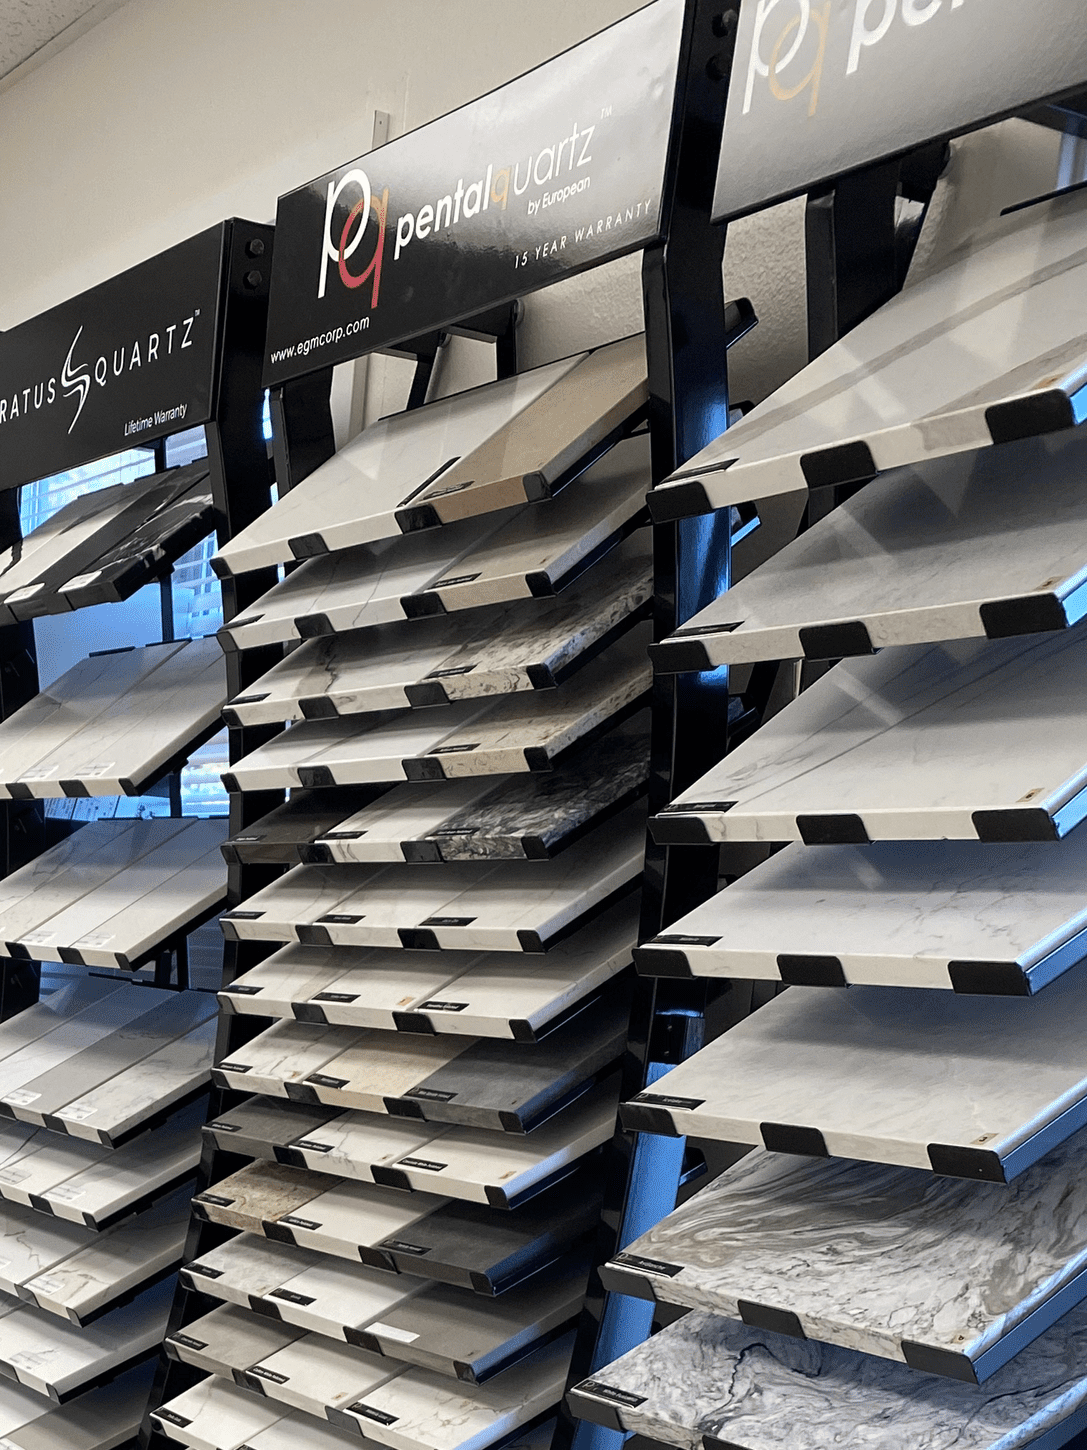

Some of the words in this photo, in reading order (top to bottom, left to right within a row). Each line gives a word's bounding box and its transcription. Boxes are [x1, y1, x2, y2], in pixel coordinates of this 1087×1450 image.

[527, 198, 541, 215] by
[541, 175, 591, 209] European
[514, 254, 529, 269] 15
[535, 234, 568, 261] YEAR
[574, 200, 652, 244] WARRANTY
[94, 317, 195, 387] QUARTZ
[270, 315, 370, 364] www.egmcorp.com
[124, 417, 153, 437] Lifetime
[153, 403, 188, 426] Warranty
